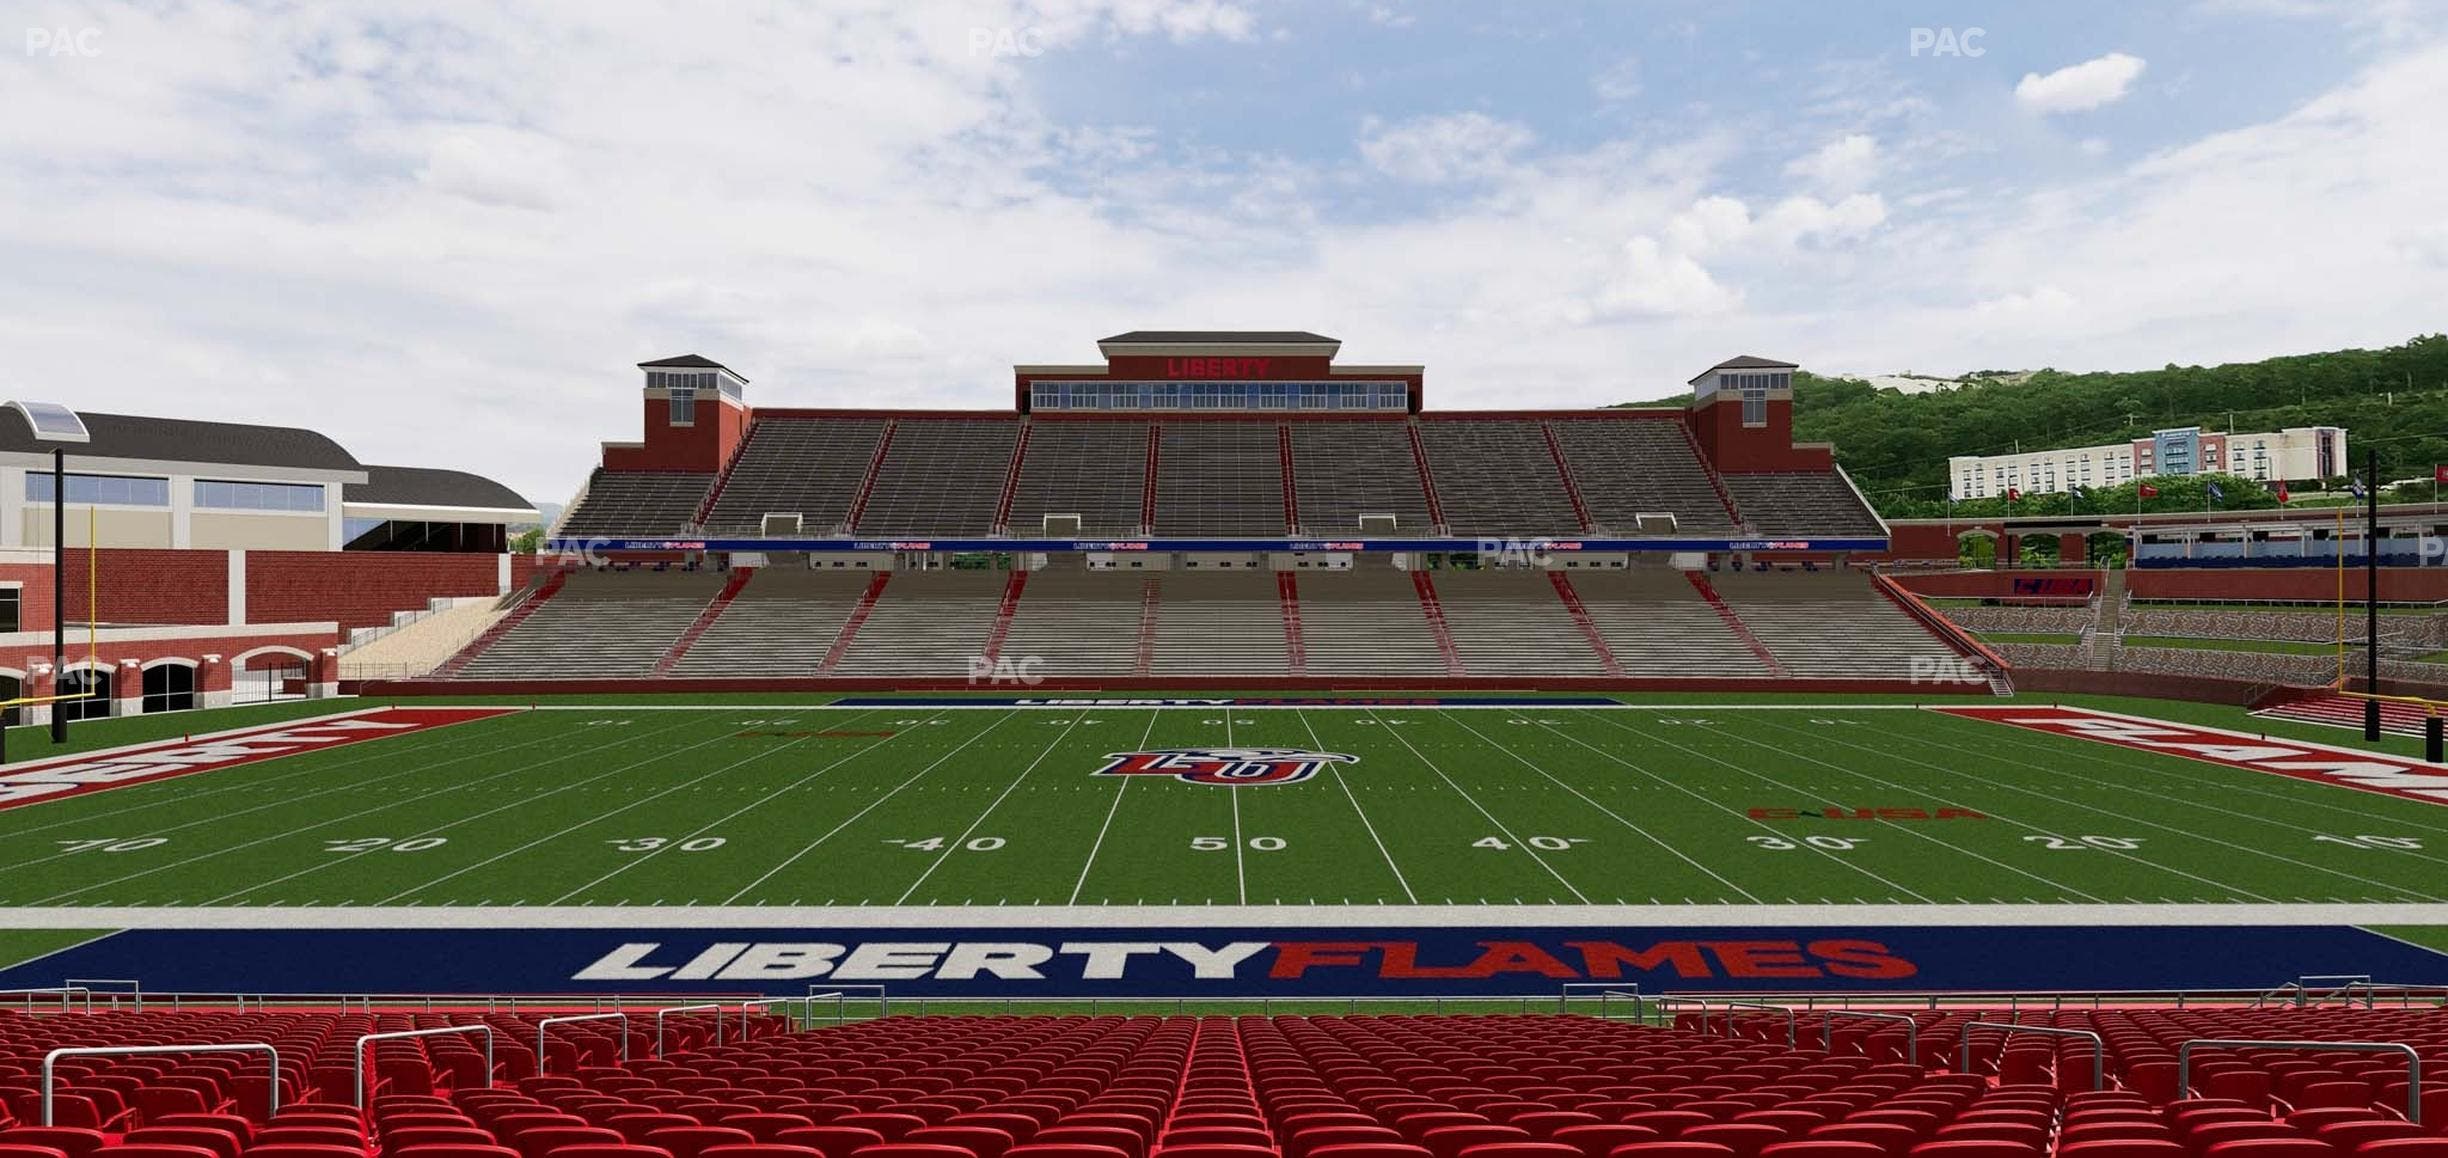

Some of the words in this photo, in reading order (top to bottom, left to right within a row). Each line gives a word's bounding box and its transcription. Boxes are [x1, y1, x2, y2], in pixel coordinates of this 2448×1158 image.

[1167, 357, 1271, 378] LIBERTY
[60, 837, 168, 851] 10
[324, 837, 447, 851] 20
[617, 837, 727, 851] 30
[902, 837, 1005, 851] 40
[1190, 836, 1287, 851] 50
[1471, 836, 1571, 850] 40
[1746, 836, 1854, 850] 30
[2023, 835, 2138, 850] 20
[571, 942, 1272, 980] LIBERTY
[1269, 941, 1917, 979] FLAMES
